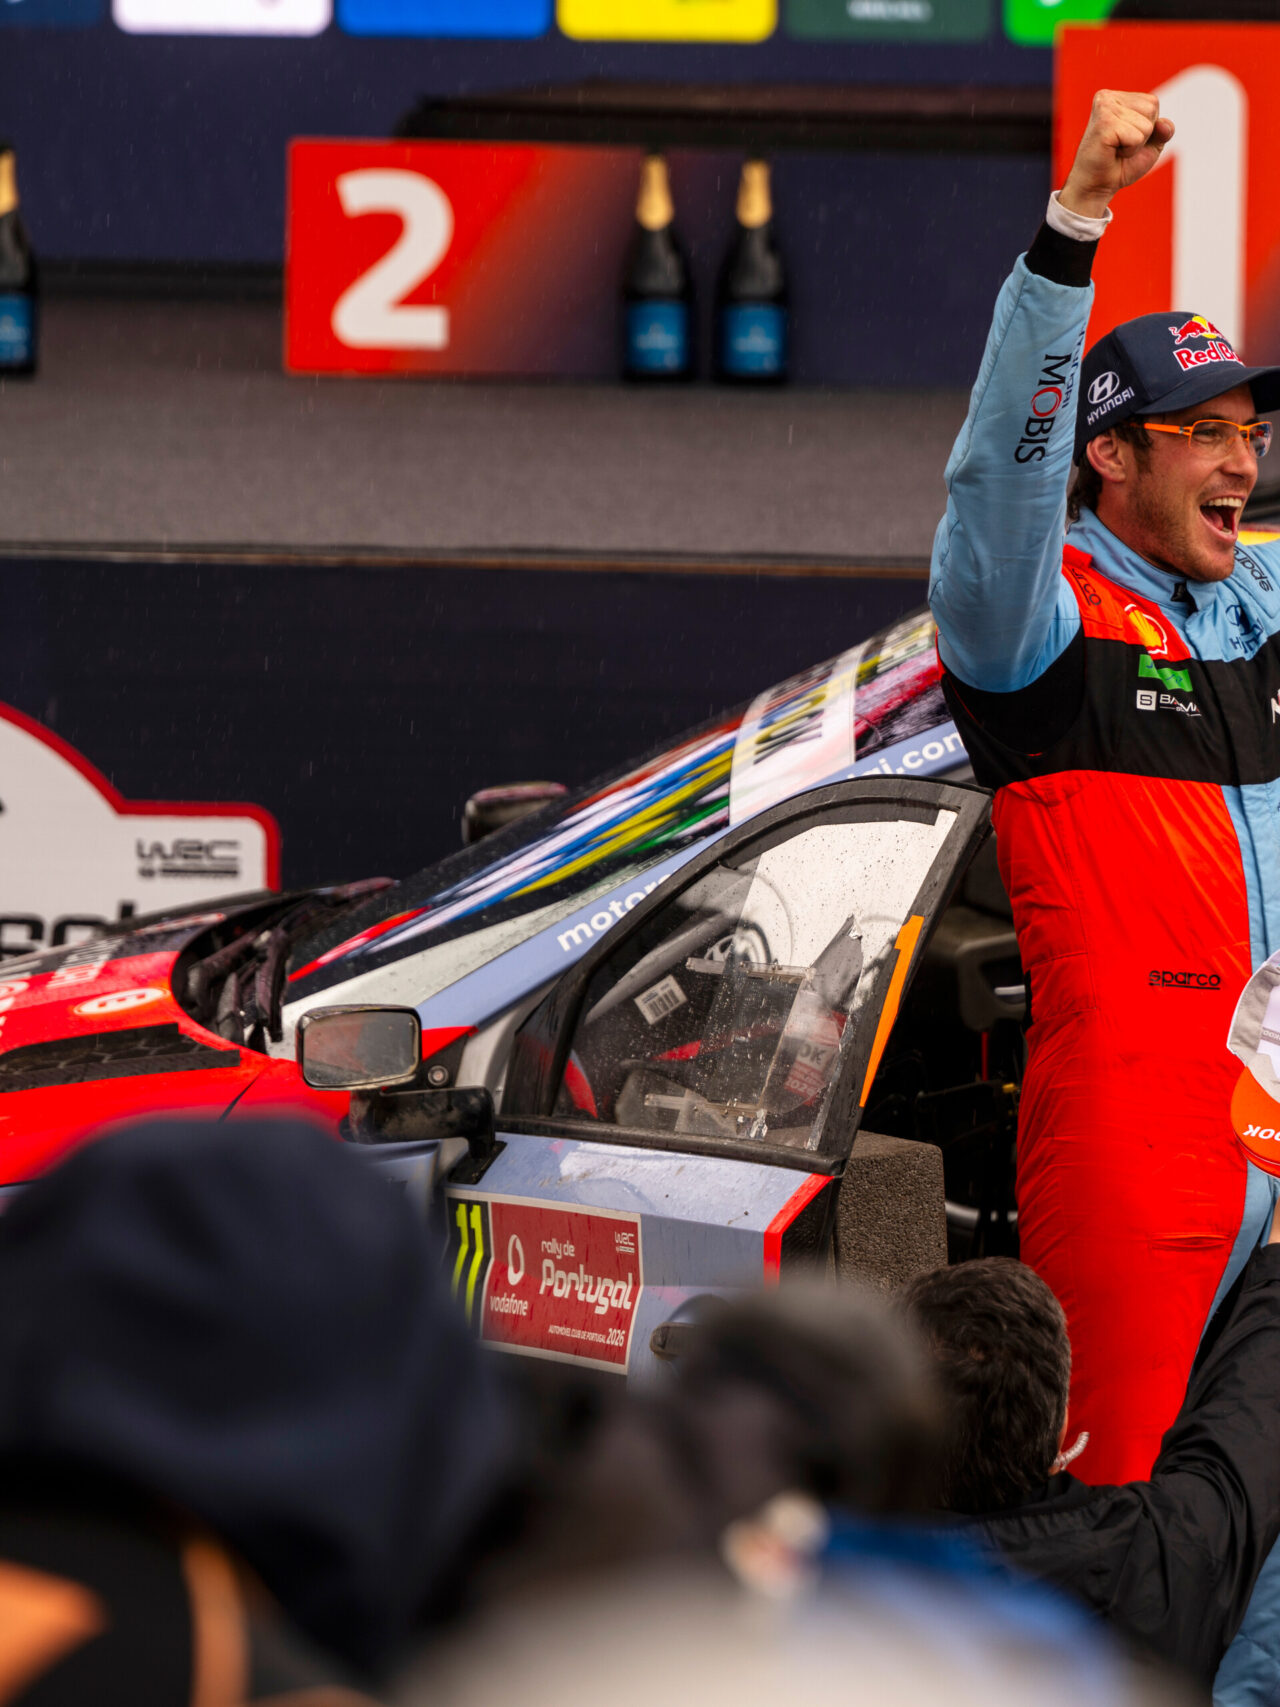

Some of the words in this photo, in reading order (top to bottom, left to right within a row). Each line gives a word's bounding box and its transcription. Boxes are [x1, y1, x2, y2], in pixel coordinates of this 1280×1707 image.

[1139, 63, 1249, 352] 1
[333, 168, 455, 350] 2
[1174, 340, 1222, 372] Red
[1014, 353, 1072, 465] MOBIS
[1086, 386, 1136, 426] HYUNDAI
[136, 838, 240, 861] WRC
[1148, 968, 1221, 991] sparco
[541, 1237, 562, 1260] rally
[562, 1240, 576, 1257] de
[538, 1258, 634, 1316] Portugal
[489, 1291, 529, 1317] vodafone
[605, 1327, 627, 1347] 2026
